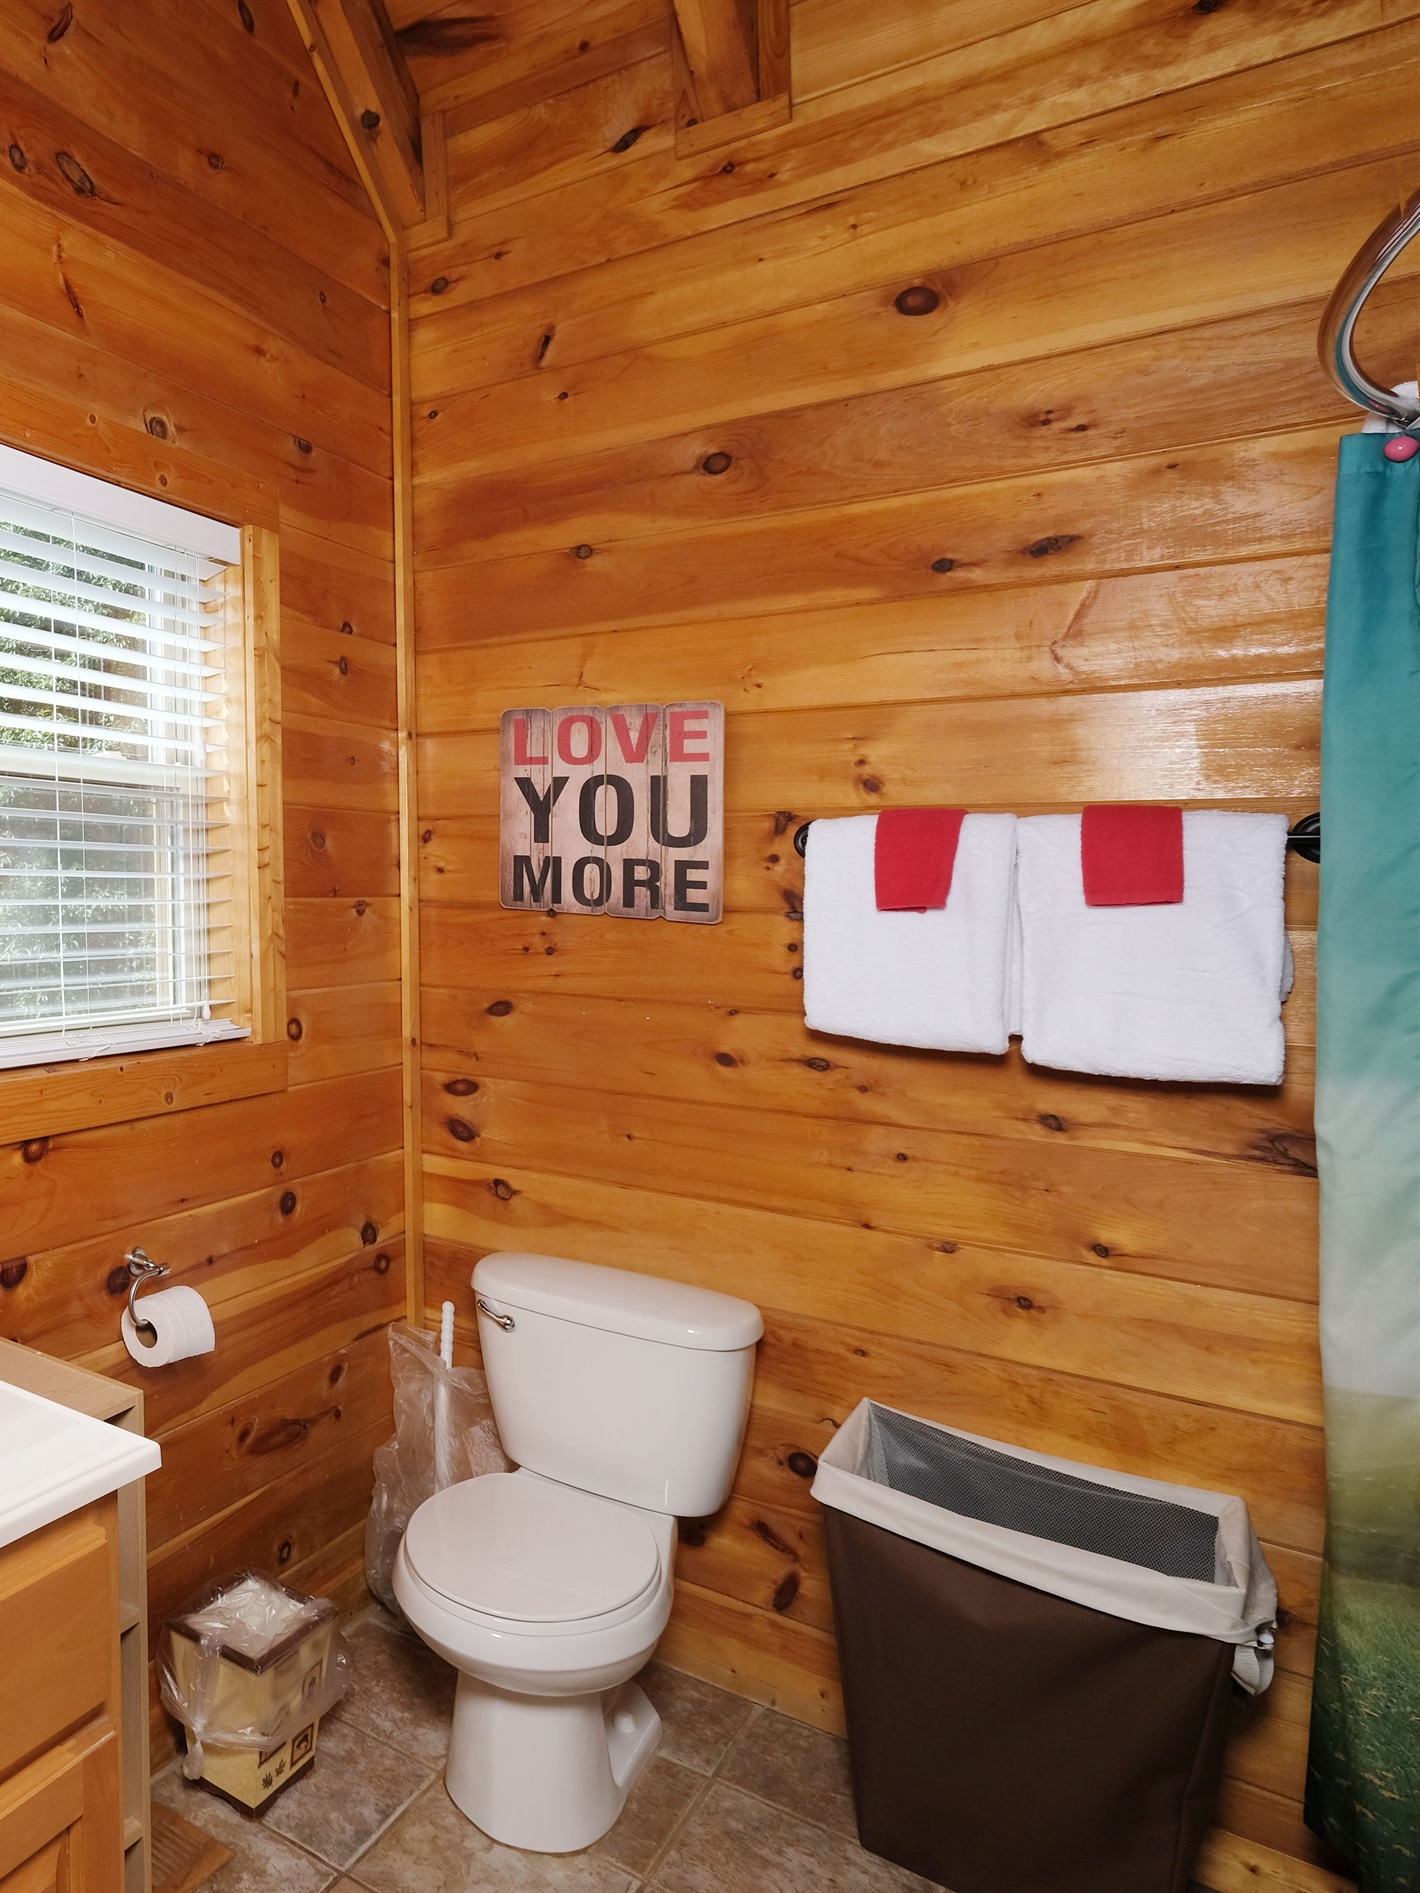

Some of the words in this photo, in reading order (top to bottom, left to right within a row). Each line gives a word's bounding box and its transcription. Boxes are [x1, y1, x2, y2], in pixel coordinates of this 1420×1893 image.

[513, 709, 710, 766] LOVE
[513, 774, 709, 848] YOU
[512, 854, 710, 913] MORE
